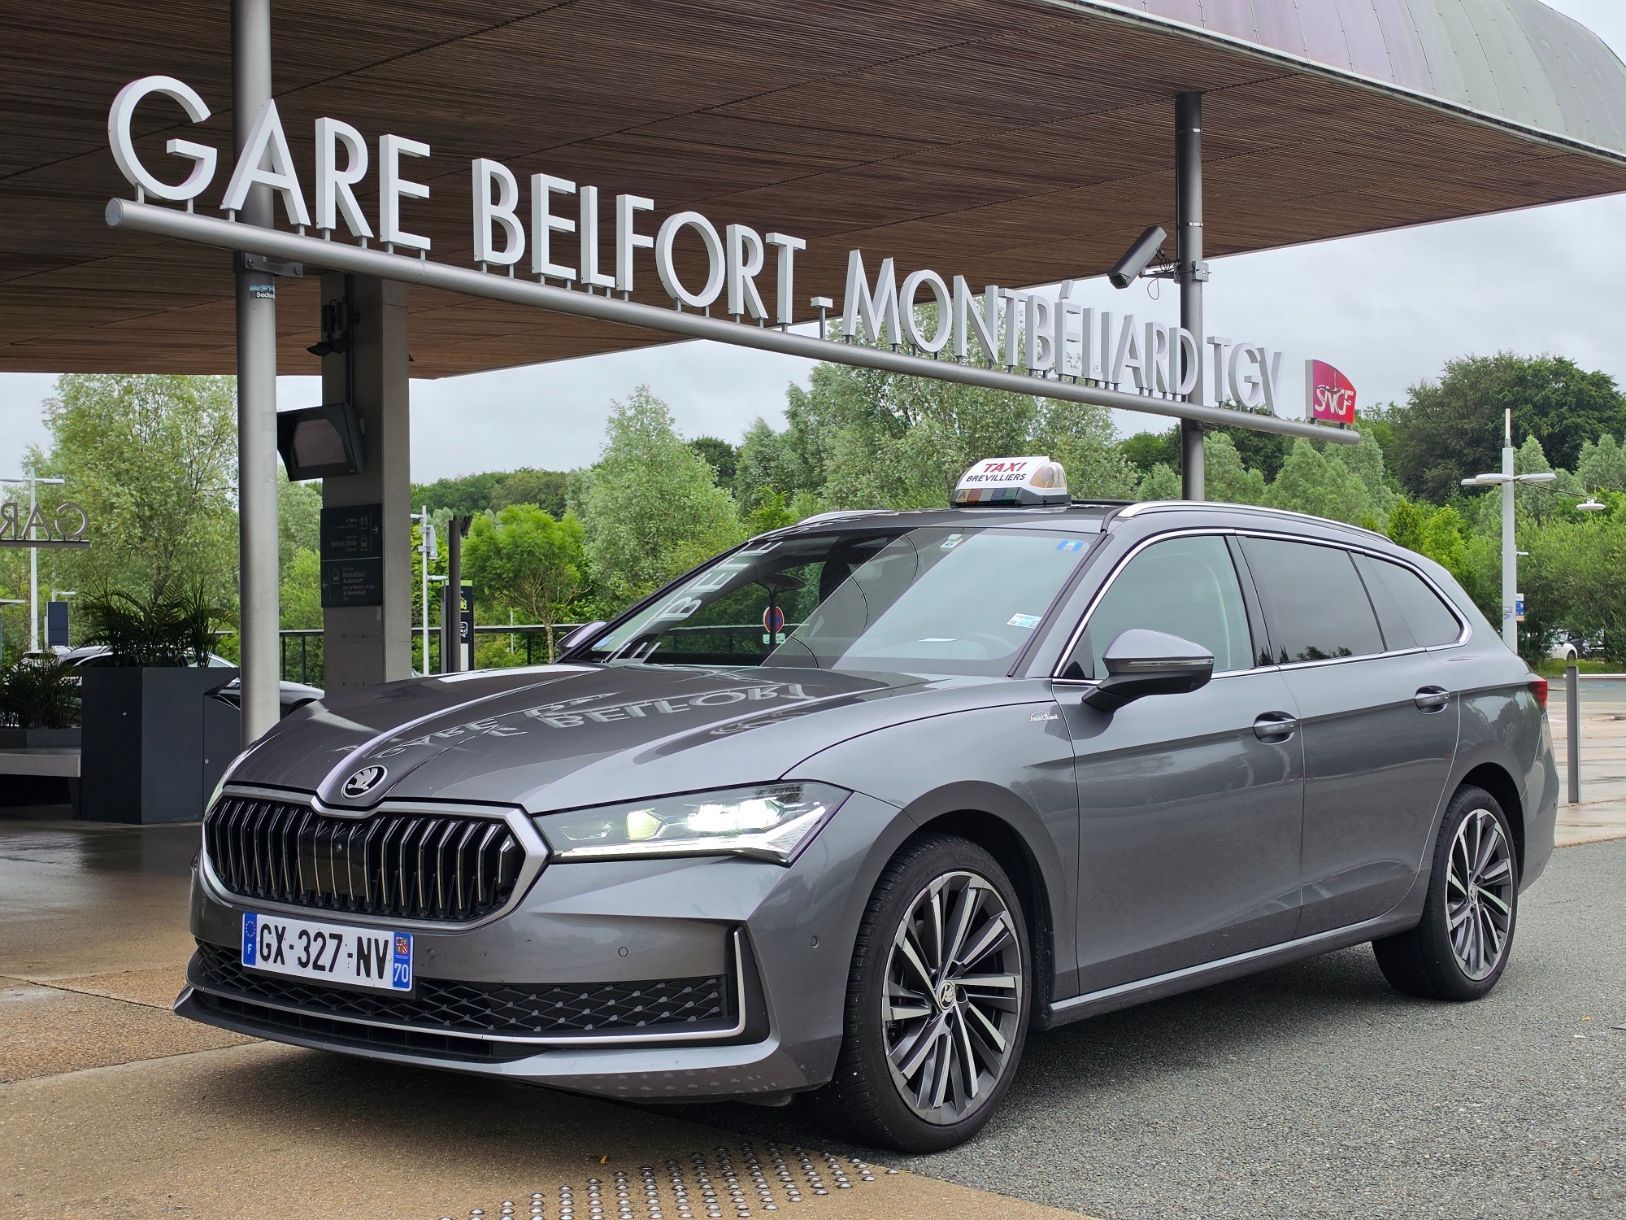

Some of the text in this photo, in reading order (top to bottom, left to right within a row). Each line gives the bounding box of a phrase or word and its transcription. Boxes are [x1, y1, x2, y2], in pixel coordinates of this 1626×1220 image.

[108, 75, 431, 251] GARE
[472, 157, 806, 325] BELFORT
[841, 249, 1198, 396] MONTBÉLIARD
[1207, 335, 1285, 416] TGV
[1315, 384, 1354, 416] SNCF
[983, 461, 1027, 473] TAXI
[966, 473, 1027, 482] BREVILLIERS
[247, 943, 253, 955] F
[259, 923, 389, 980] GX-327-NV
[393, 963, 409, 983] 70
